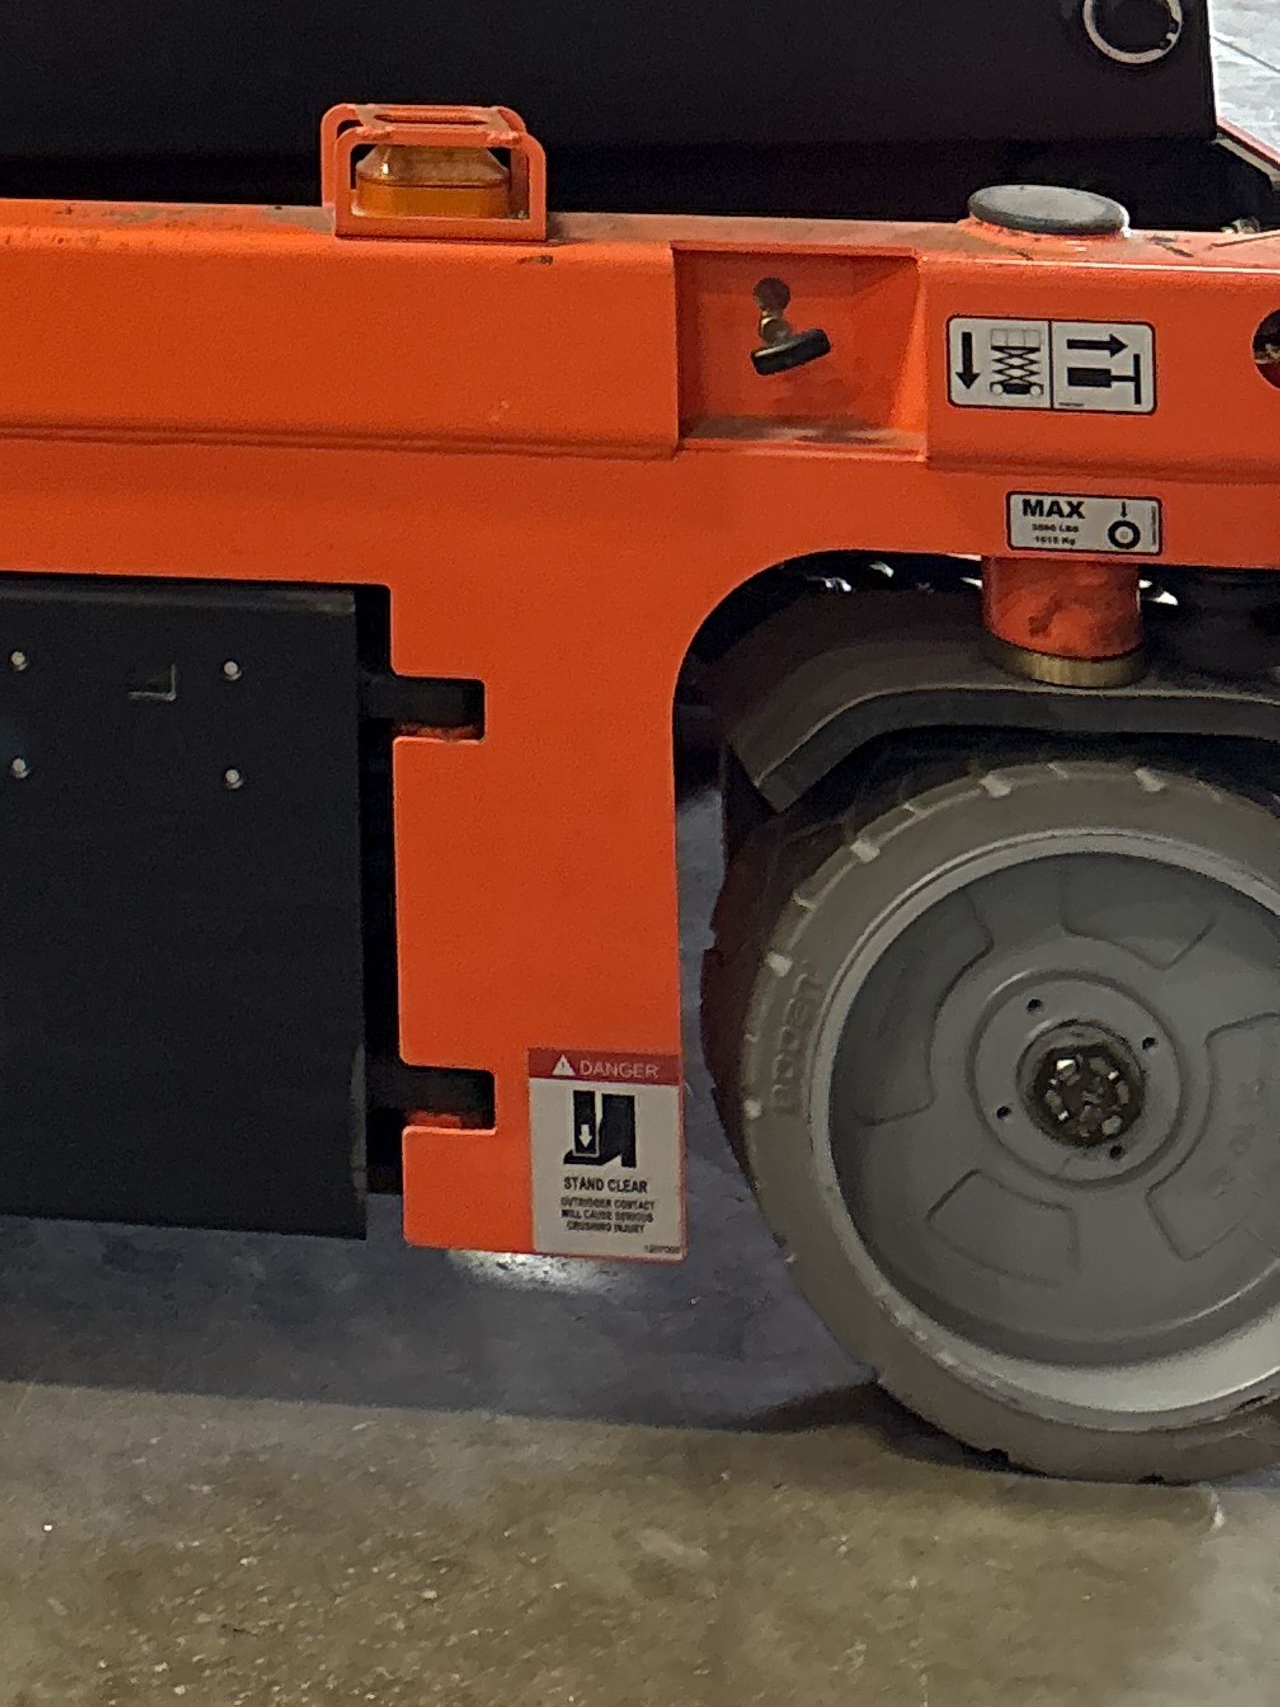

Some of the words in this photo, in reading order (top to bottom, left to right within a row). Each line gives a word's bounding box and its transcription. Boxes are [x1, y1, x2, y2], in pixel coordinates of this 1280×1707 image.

[1022, 498, 1086, 519] MAX
[580, 1060, 659, 1079] DANGER
[563, 1176, 604, 1191] STAND
[607, 1179, 648, 1194] CLEAR
